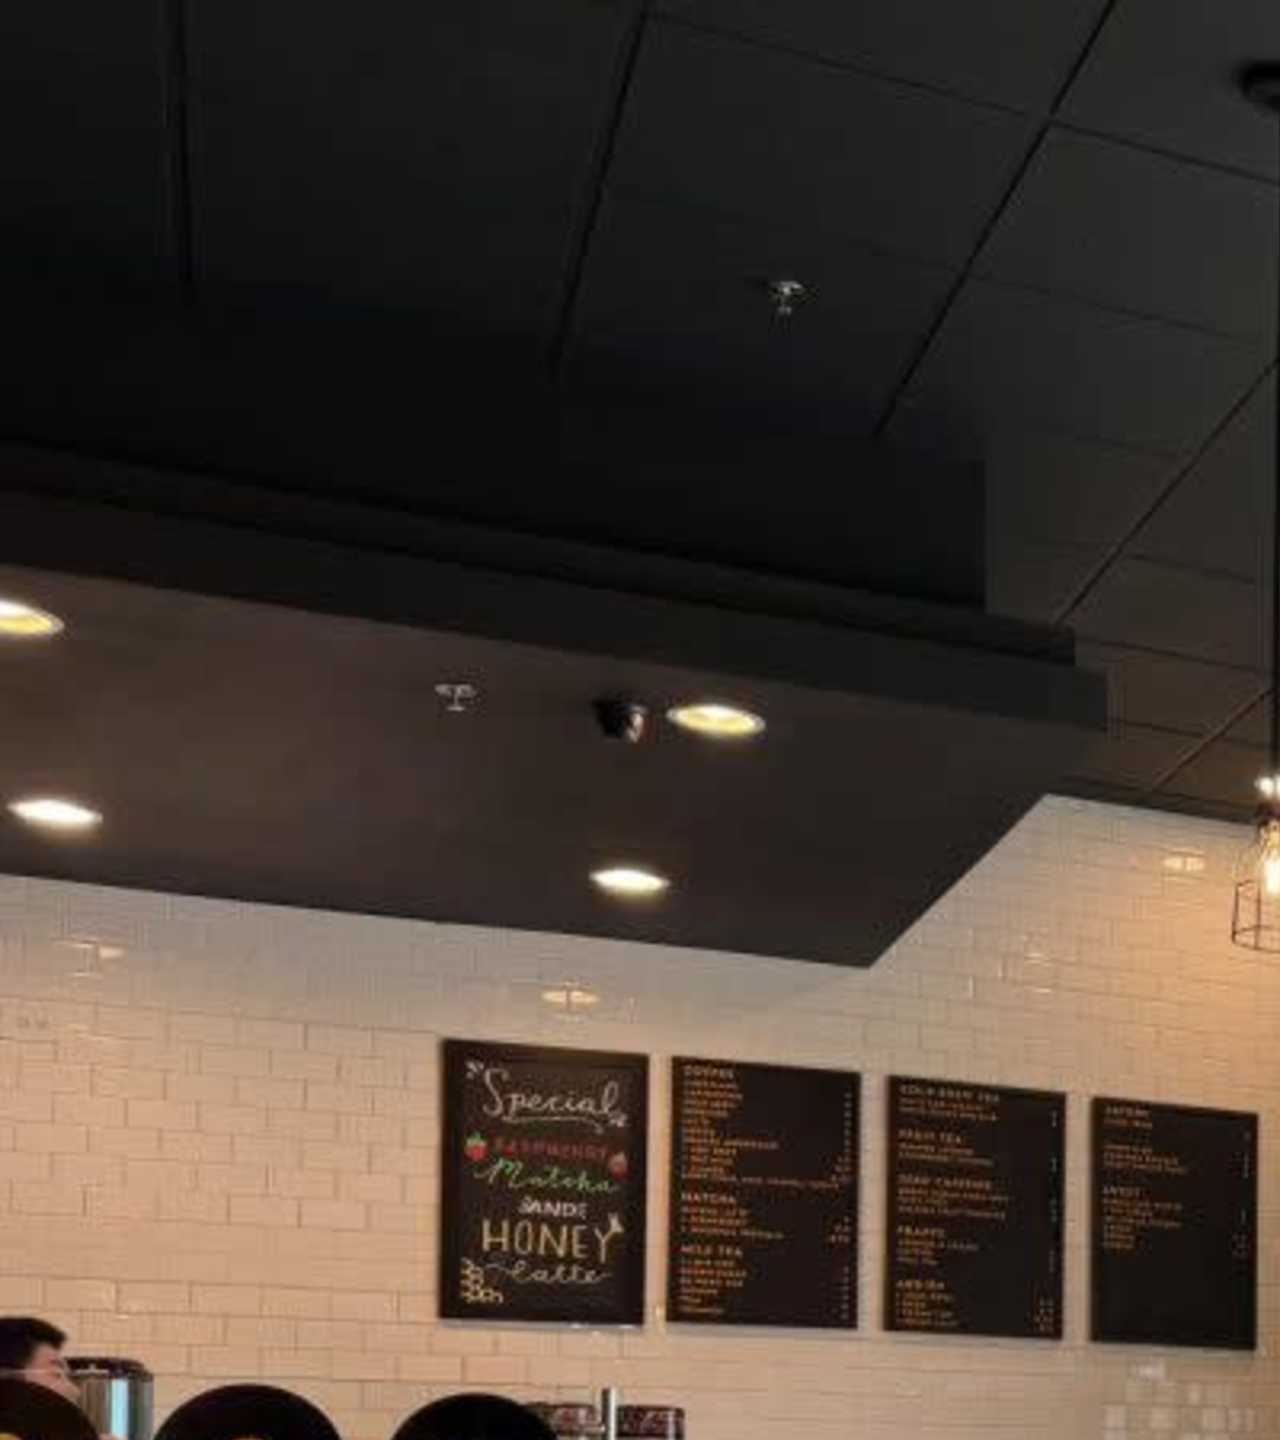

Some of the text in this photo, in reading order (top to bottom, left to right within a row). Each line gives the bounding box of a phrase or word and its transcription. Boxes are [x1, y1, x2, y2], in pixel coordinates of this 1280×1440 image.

[482, 1068, 620, 1119] Special
[474, 1157, 618, 1193] Matcha
[482, 1218, 617, 1264] HONEY
